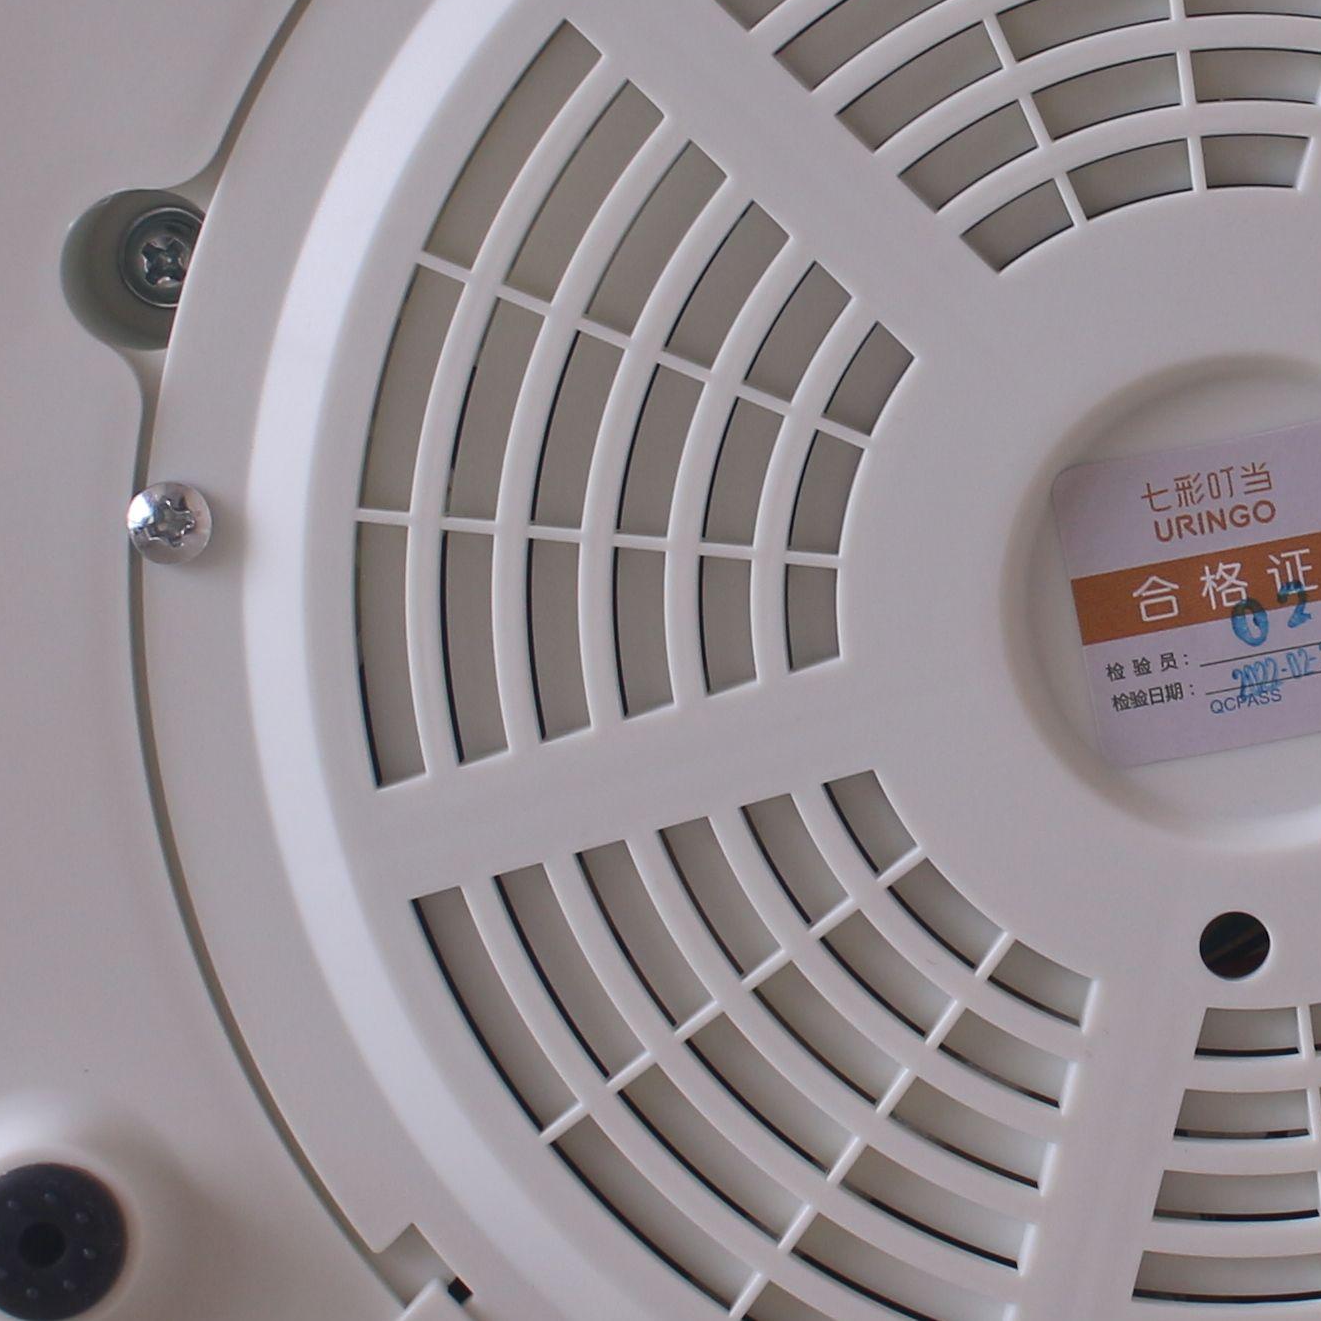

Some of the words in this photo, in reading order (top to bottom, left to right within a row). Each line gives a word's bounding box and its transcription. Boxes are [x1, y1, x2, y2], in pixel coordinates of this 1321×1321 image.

[1141, 462, 1272, 512] 七彩叮当
[1154, 500, 1276, 543] URINGO
[1132, 548, 1318, 622] 合格证
